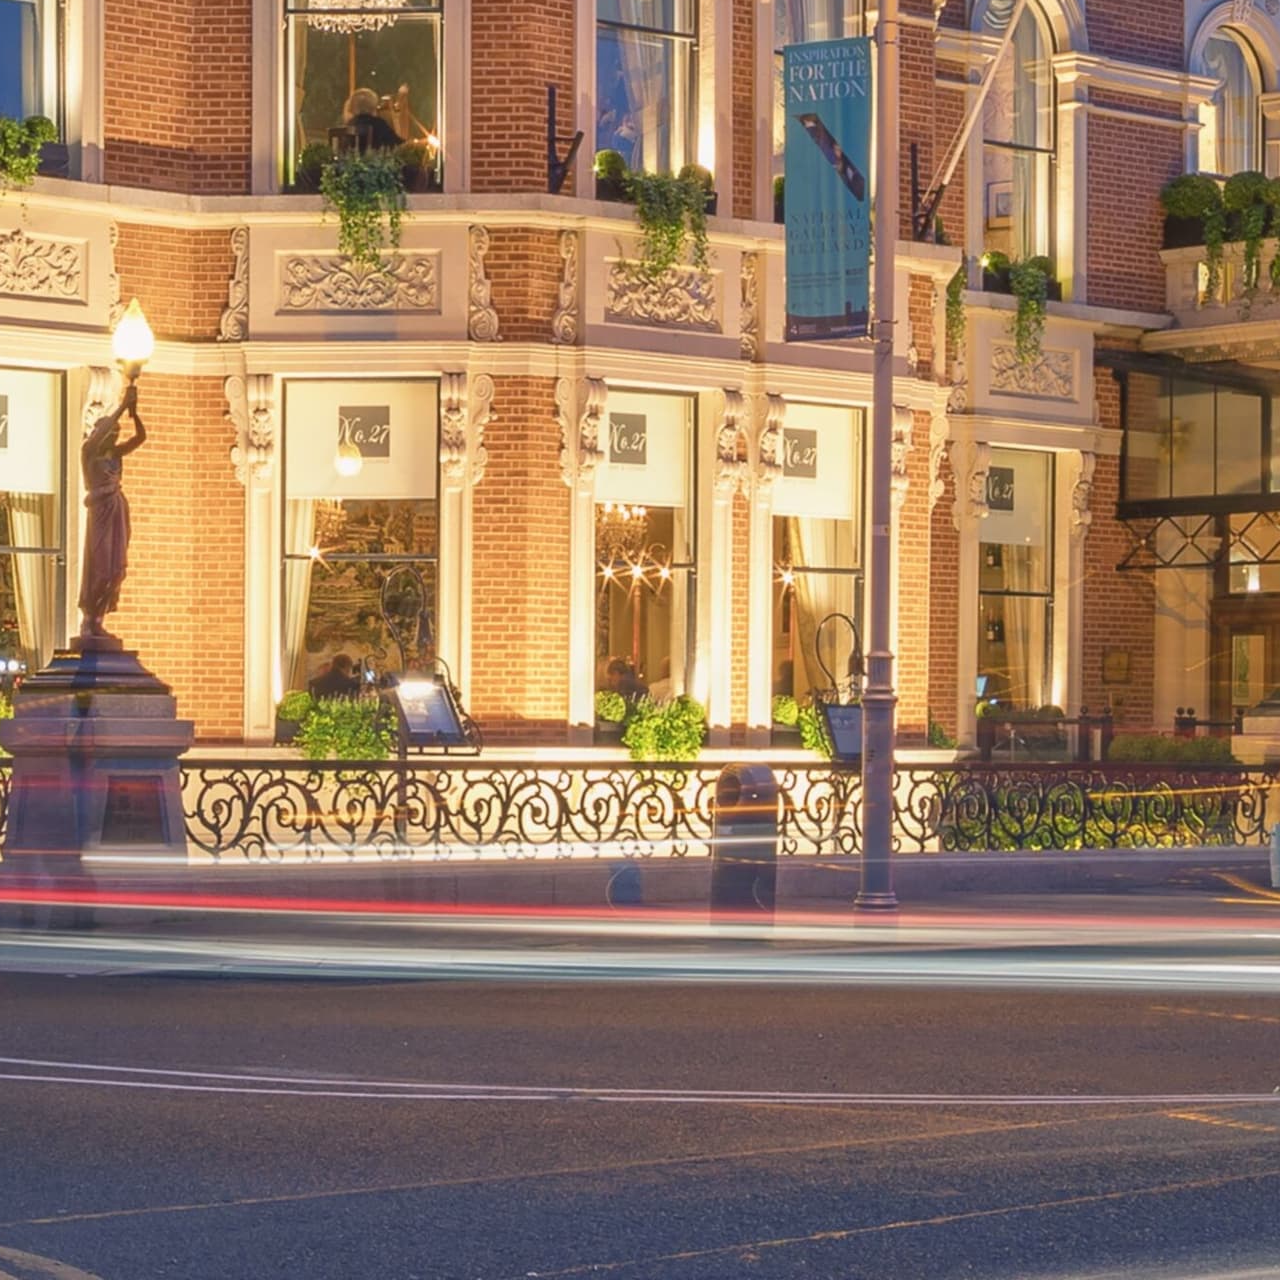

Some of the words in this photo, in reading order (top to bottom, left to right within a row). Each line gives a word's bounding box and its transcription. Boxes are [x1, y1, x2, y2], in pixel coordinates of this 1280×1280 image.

[789, 44, 865, 64] INSPIRATION
[790, 63, 824, 82] FOR
[827, 60, 867, 78] THE
[790, 79, 866, 103] NATION
[791, 207, 864, 225] NATIOAL
[790, 223, 858, 240] GALLEY
[339, 415, 390, 447] No.27
[610, 422, 646, 453] No.27
